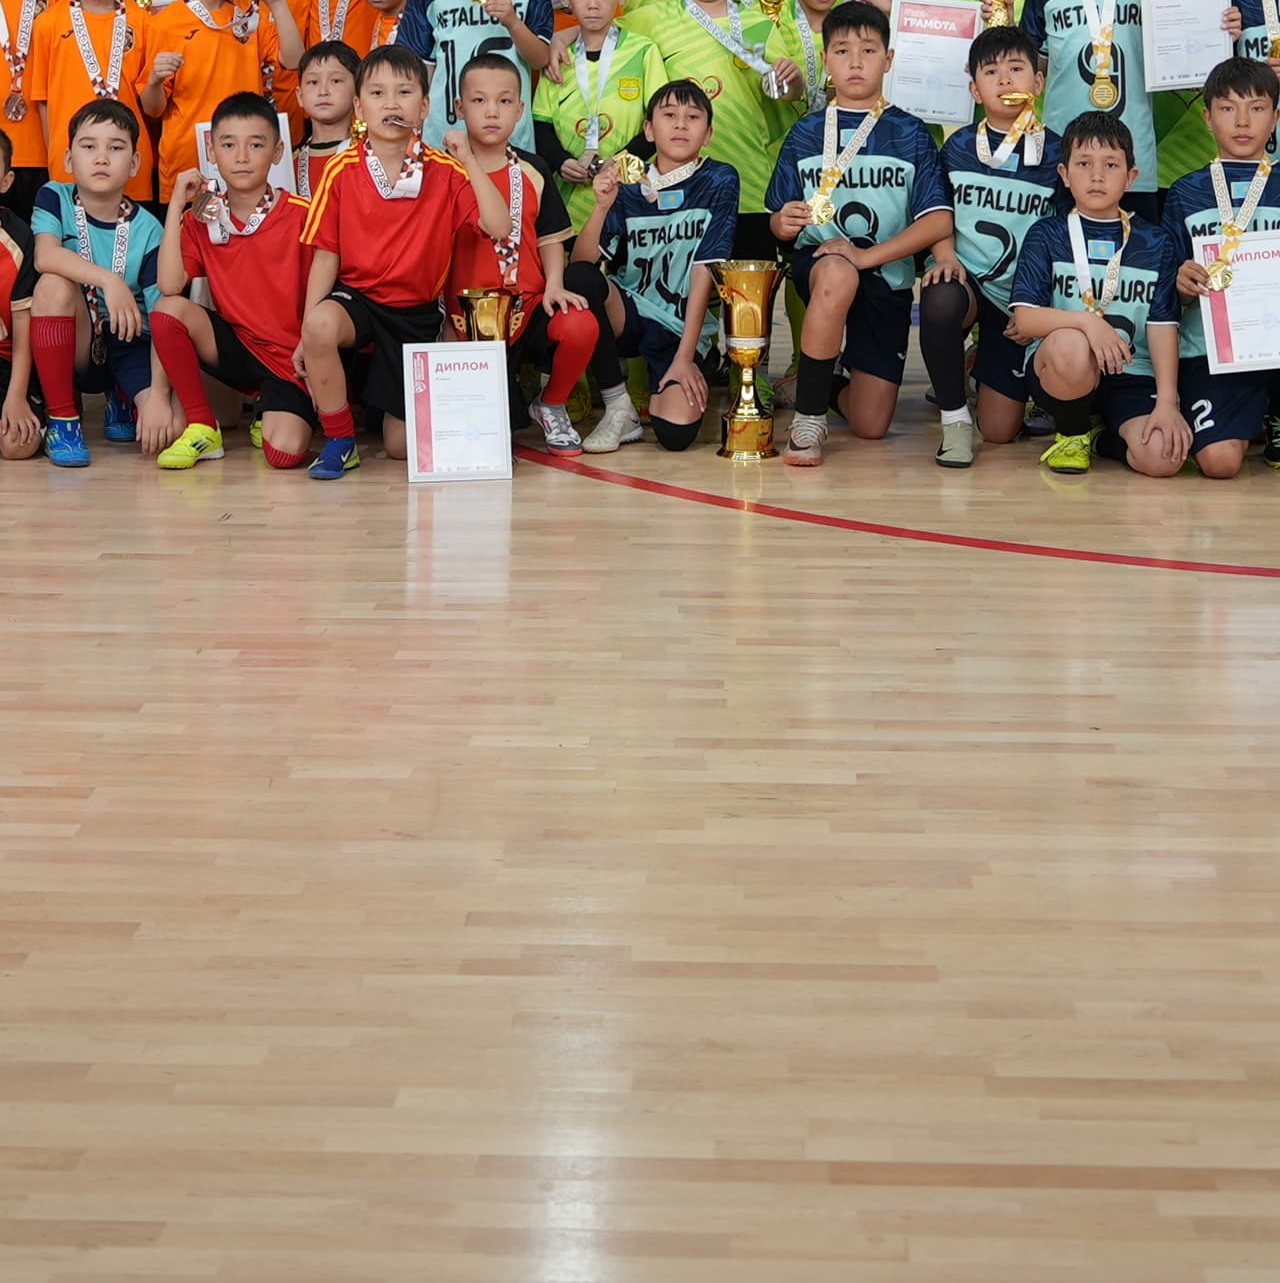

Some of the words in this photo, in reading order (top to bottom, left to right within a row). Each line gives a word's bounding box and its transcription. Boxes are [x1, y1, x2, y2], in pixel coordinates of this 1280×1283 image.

[903, 16, 957, 31] ГРАМОТА
[800, 167, 906, 189] MEALLURG
[435, 361, 489, 374] ДИПЛОМ
[1191, 399, 1216, 433] 2
